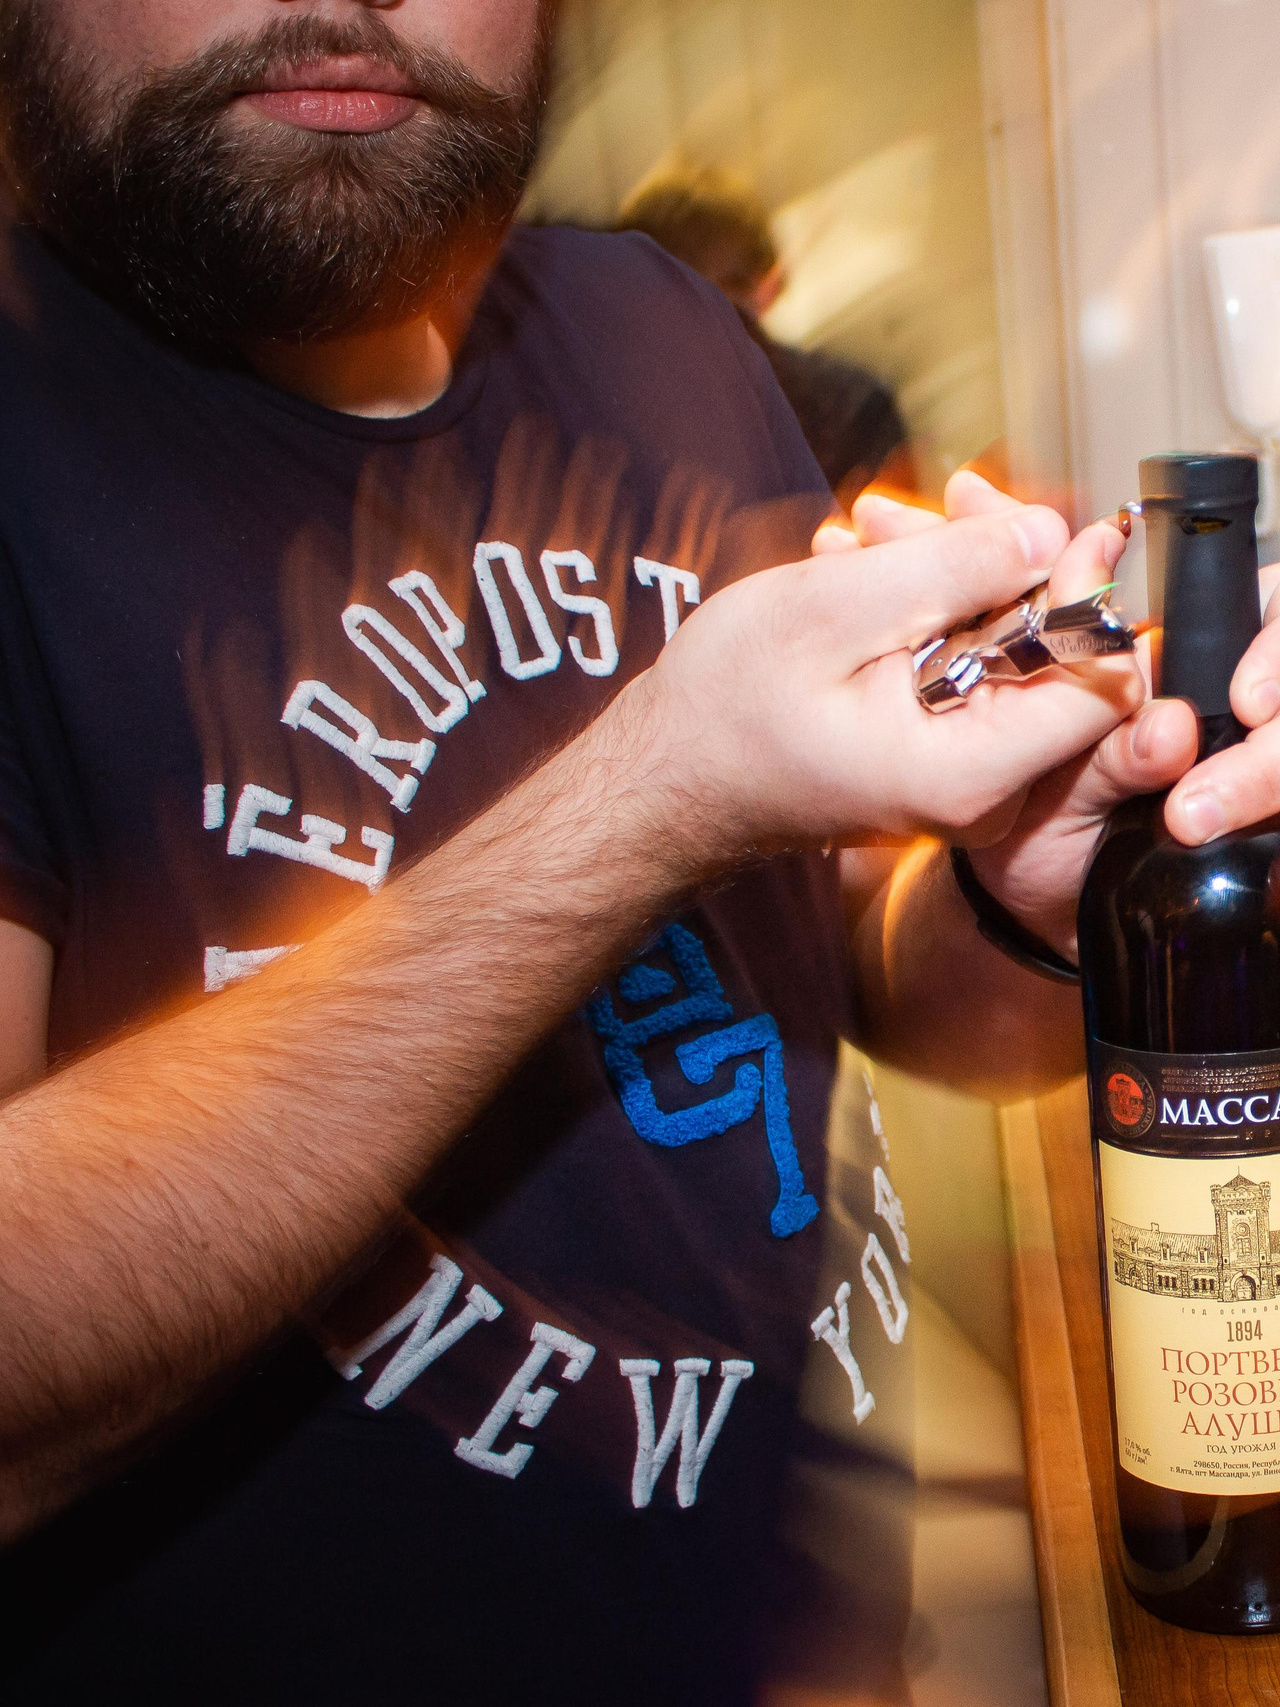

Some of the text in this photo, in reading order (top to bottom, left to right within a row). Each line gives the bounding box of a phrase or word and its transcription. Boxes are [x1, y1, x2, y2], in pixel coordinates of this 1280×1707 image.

[330, 1071, 912, 1509] NEW YOR
[1226, 1319, 1264, 1342] 1894
[1206, 1444, 1228, 1455] ГОД
[1230, 1441, 1277, 1455] УРОЖАЯ
[1193, 1460, 1222, 1470] 298650,
[1223, 1462, 1251, 1470] Россия,
[1175, 1466, 1194, 1477] Ялта,
[1208, 1470, 1251, 1480] Массандра,
[1251, 1469, 1263, 1478] ул.
